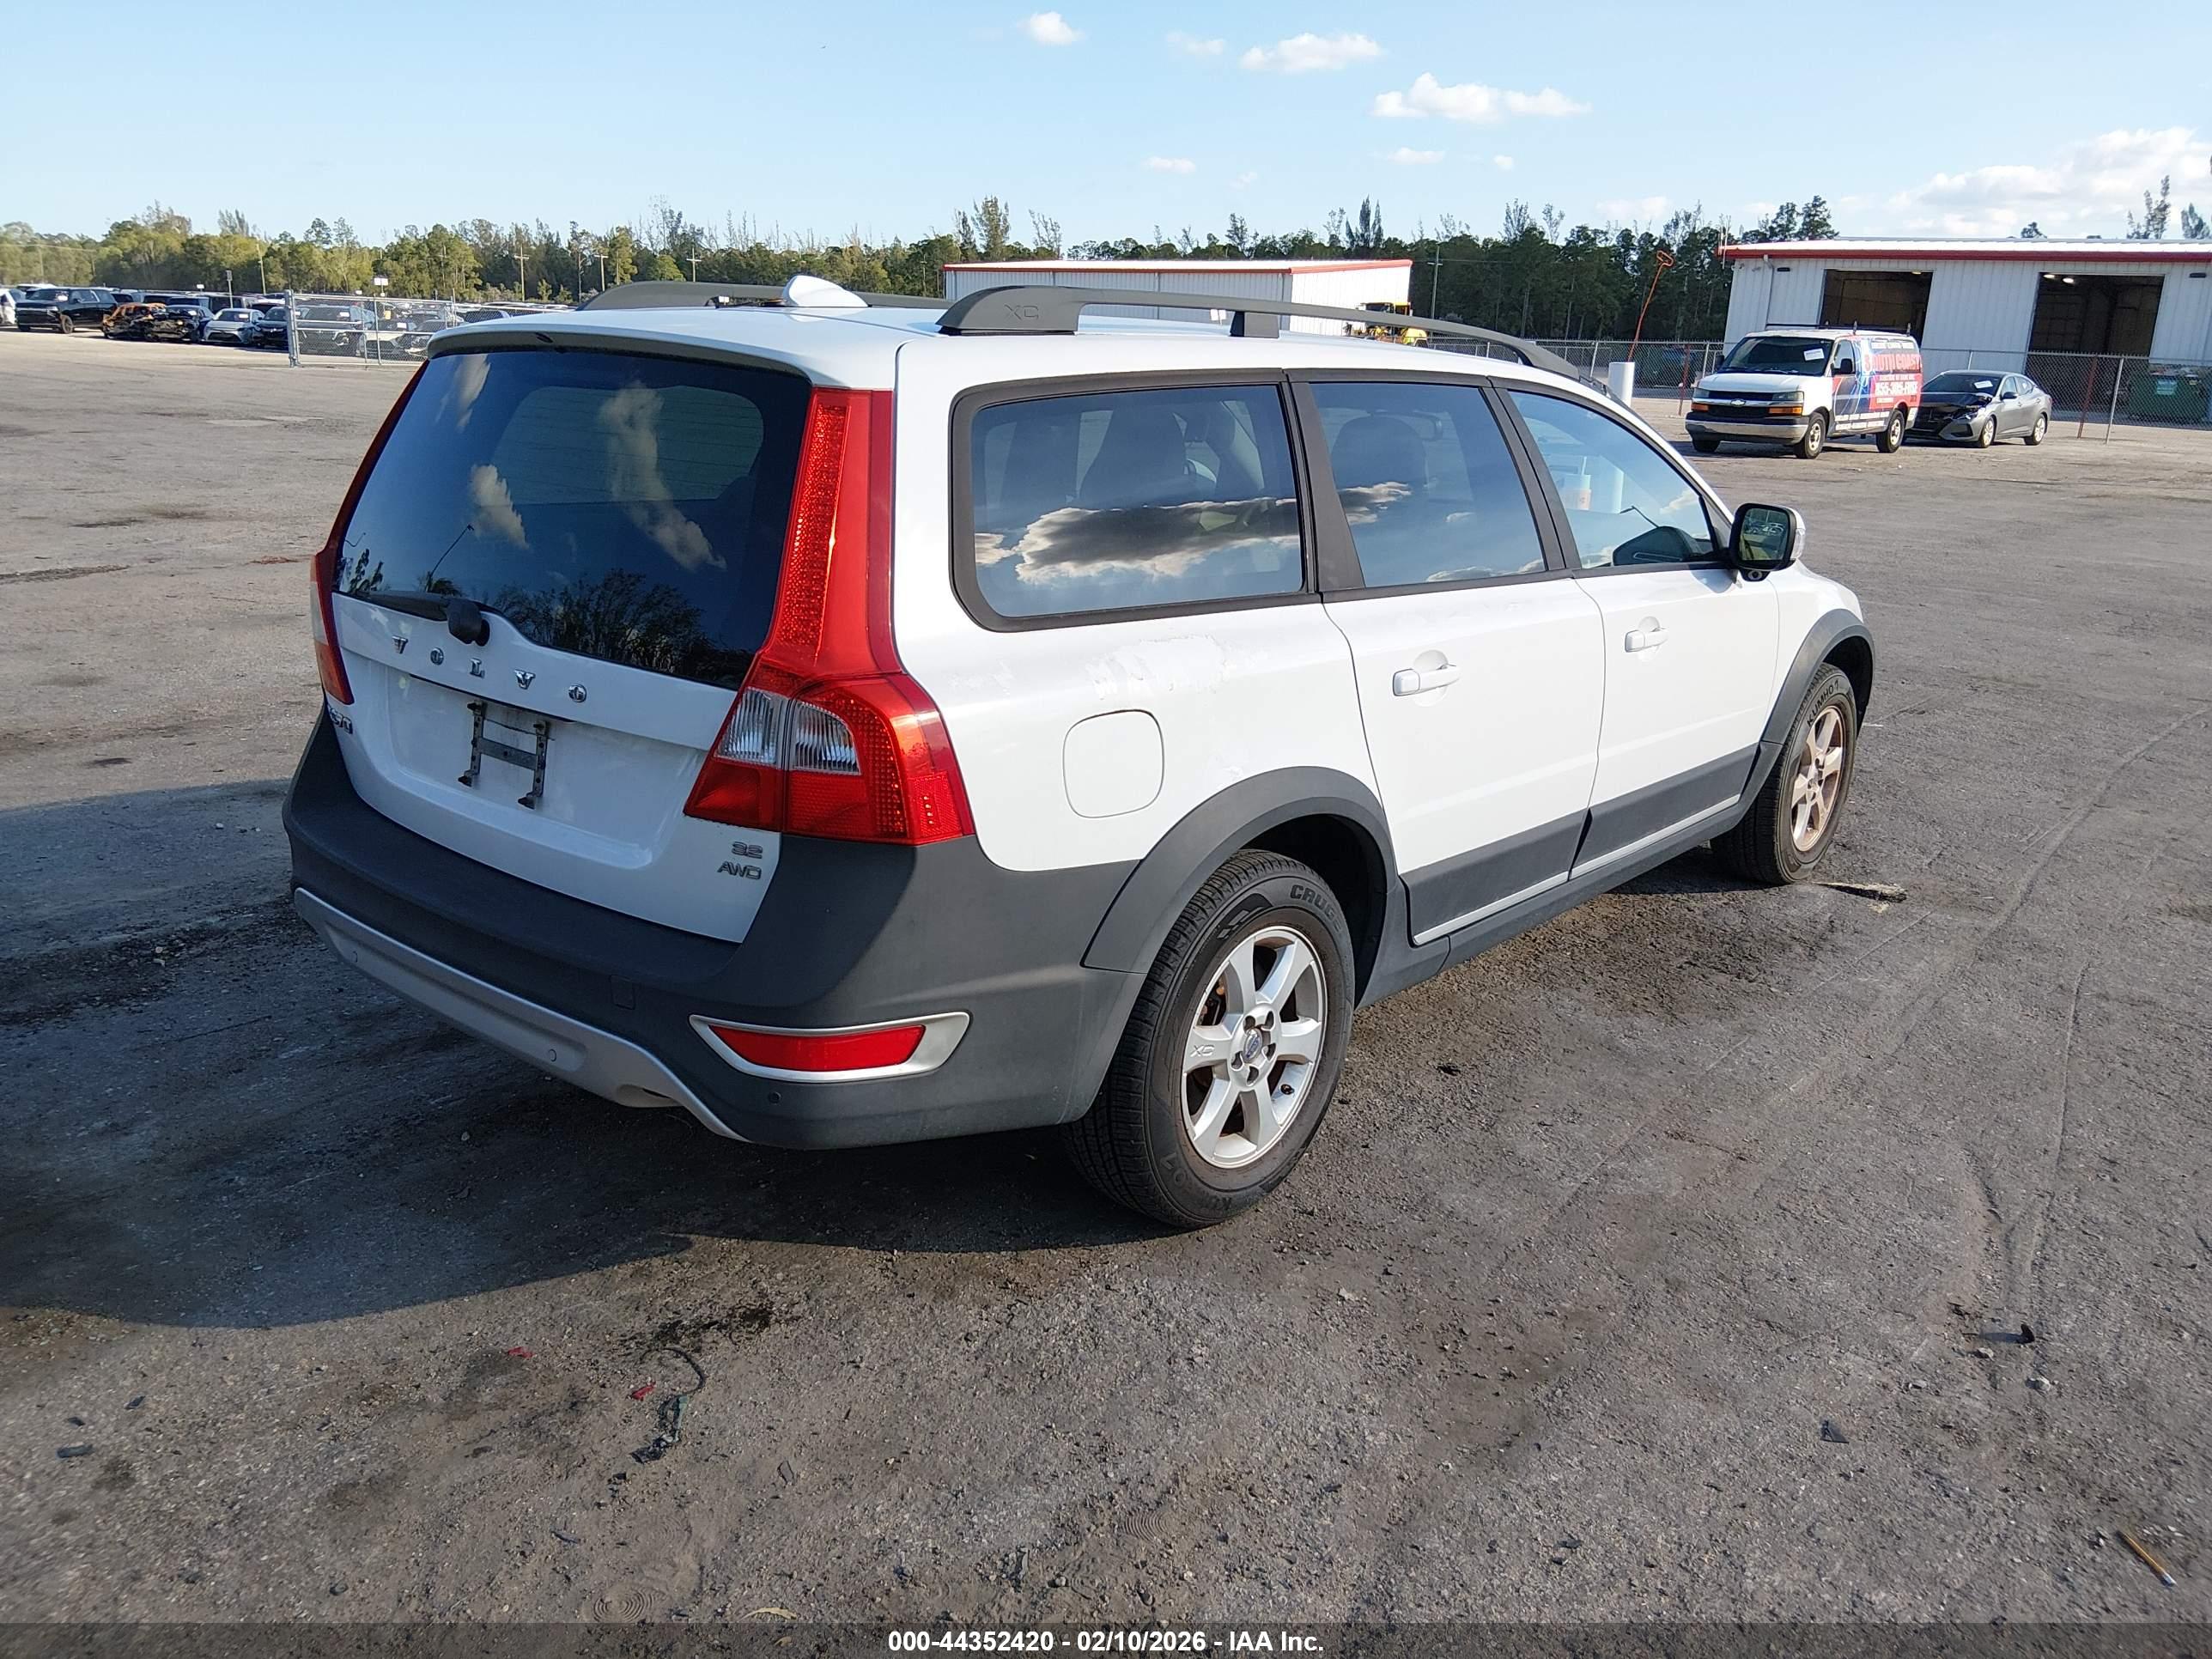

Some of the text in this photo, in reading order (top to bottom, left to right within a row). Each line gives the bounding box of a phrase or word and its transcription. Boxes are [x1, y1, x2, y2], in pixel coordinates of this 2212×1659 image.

[392, 635, 587, 703] VOLVO
[1807, 684, 1834, 727] KUMHO
[717, 860, 762, 880] AWD
